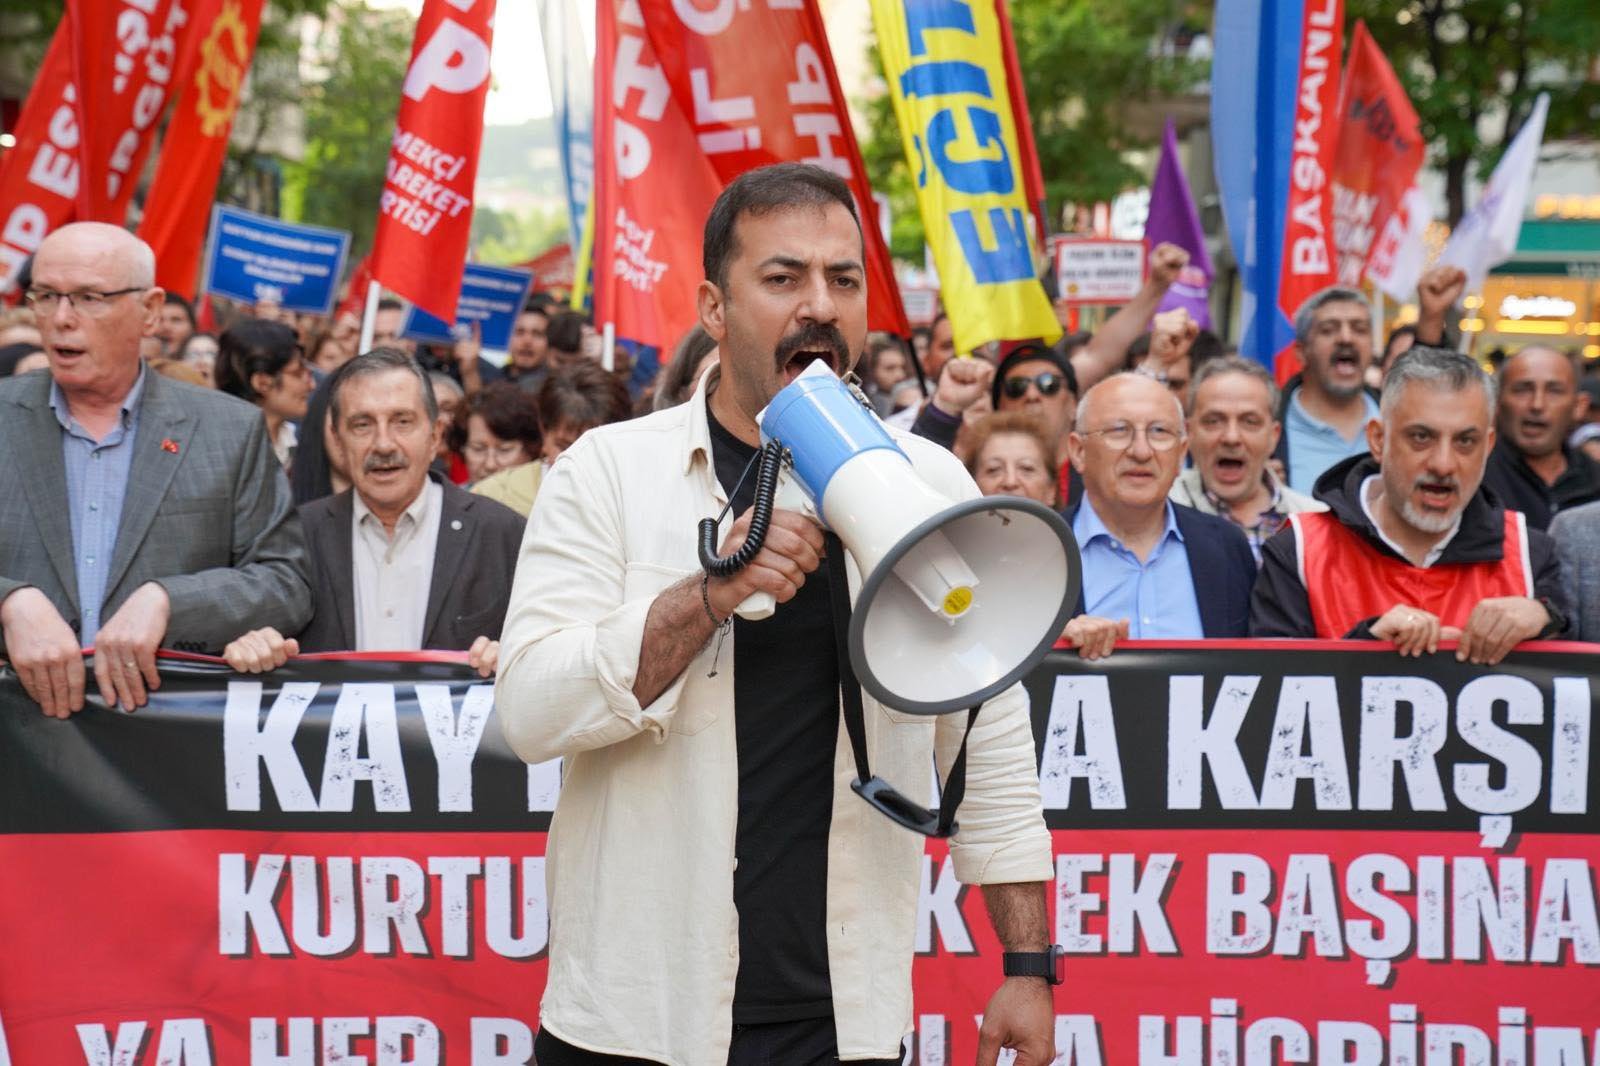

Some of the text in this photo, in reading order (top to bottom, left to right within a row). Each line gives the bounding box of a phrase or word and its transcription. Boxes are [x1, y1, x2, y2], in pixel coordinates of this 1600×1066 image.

[1167, 675, 1591, 848] KARŞI
[218, 853, 548, 957] KURTU
[1206, 853, 1600, 985] BAŞINA
